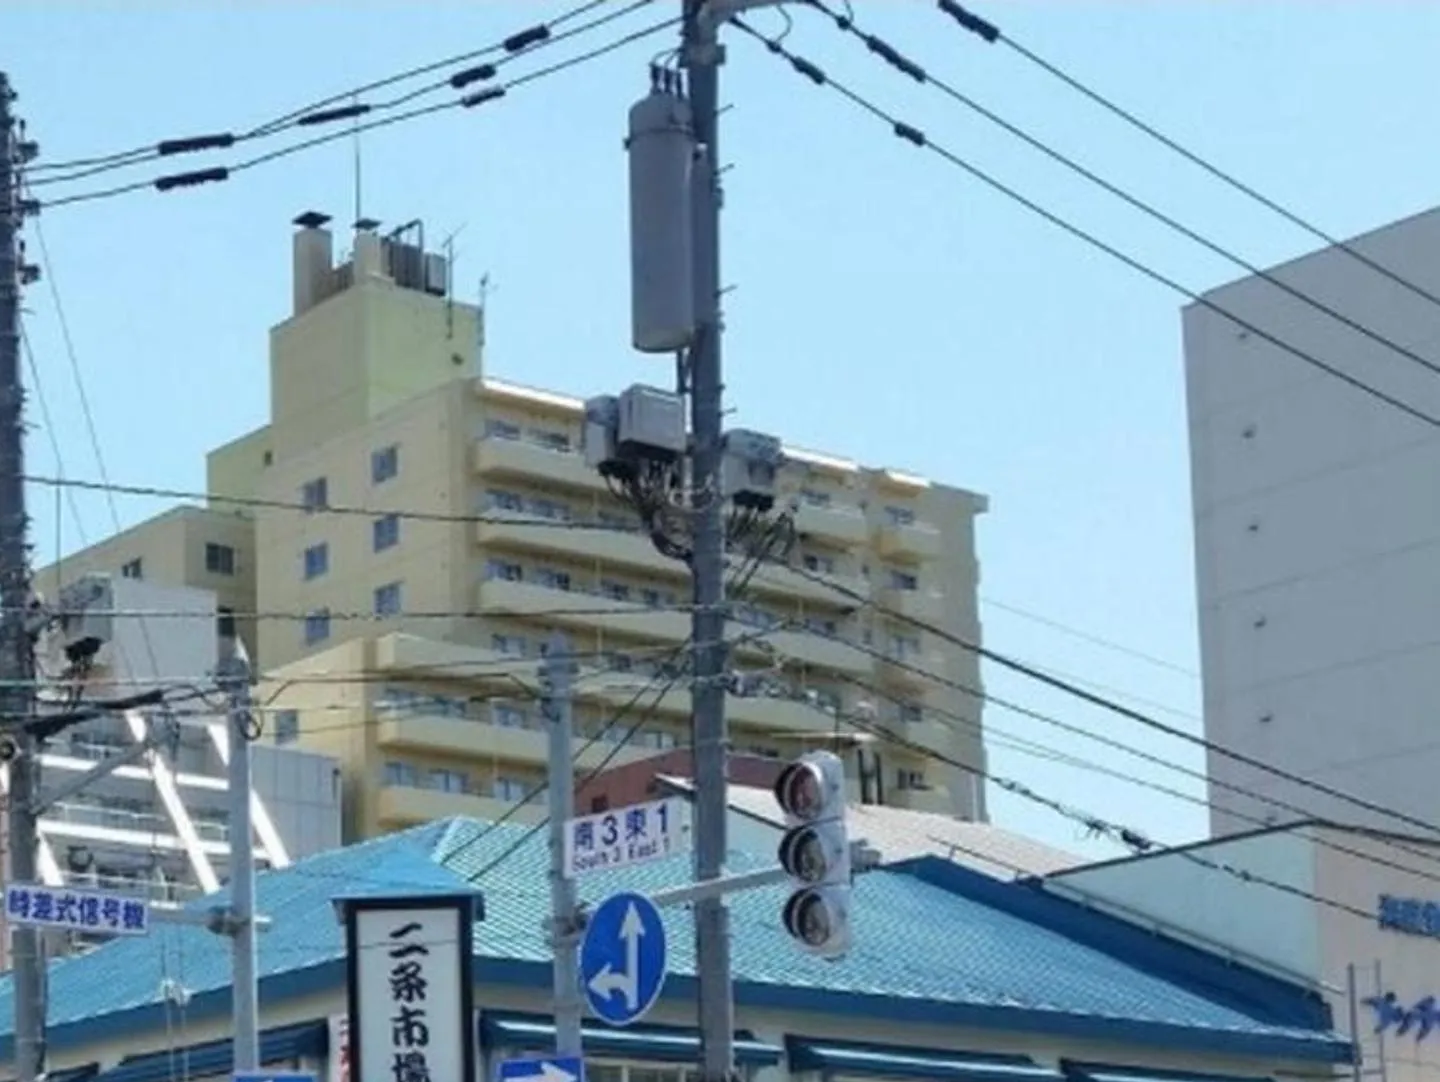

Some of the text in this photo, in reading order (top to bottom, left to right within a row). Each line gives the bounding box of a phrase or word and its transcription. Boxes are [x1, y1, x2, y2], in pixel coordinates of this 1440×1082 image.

[573, 803, 668, 851] 南3東1
[9, 889, 144, 930] 時差式信号機
